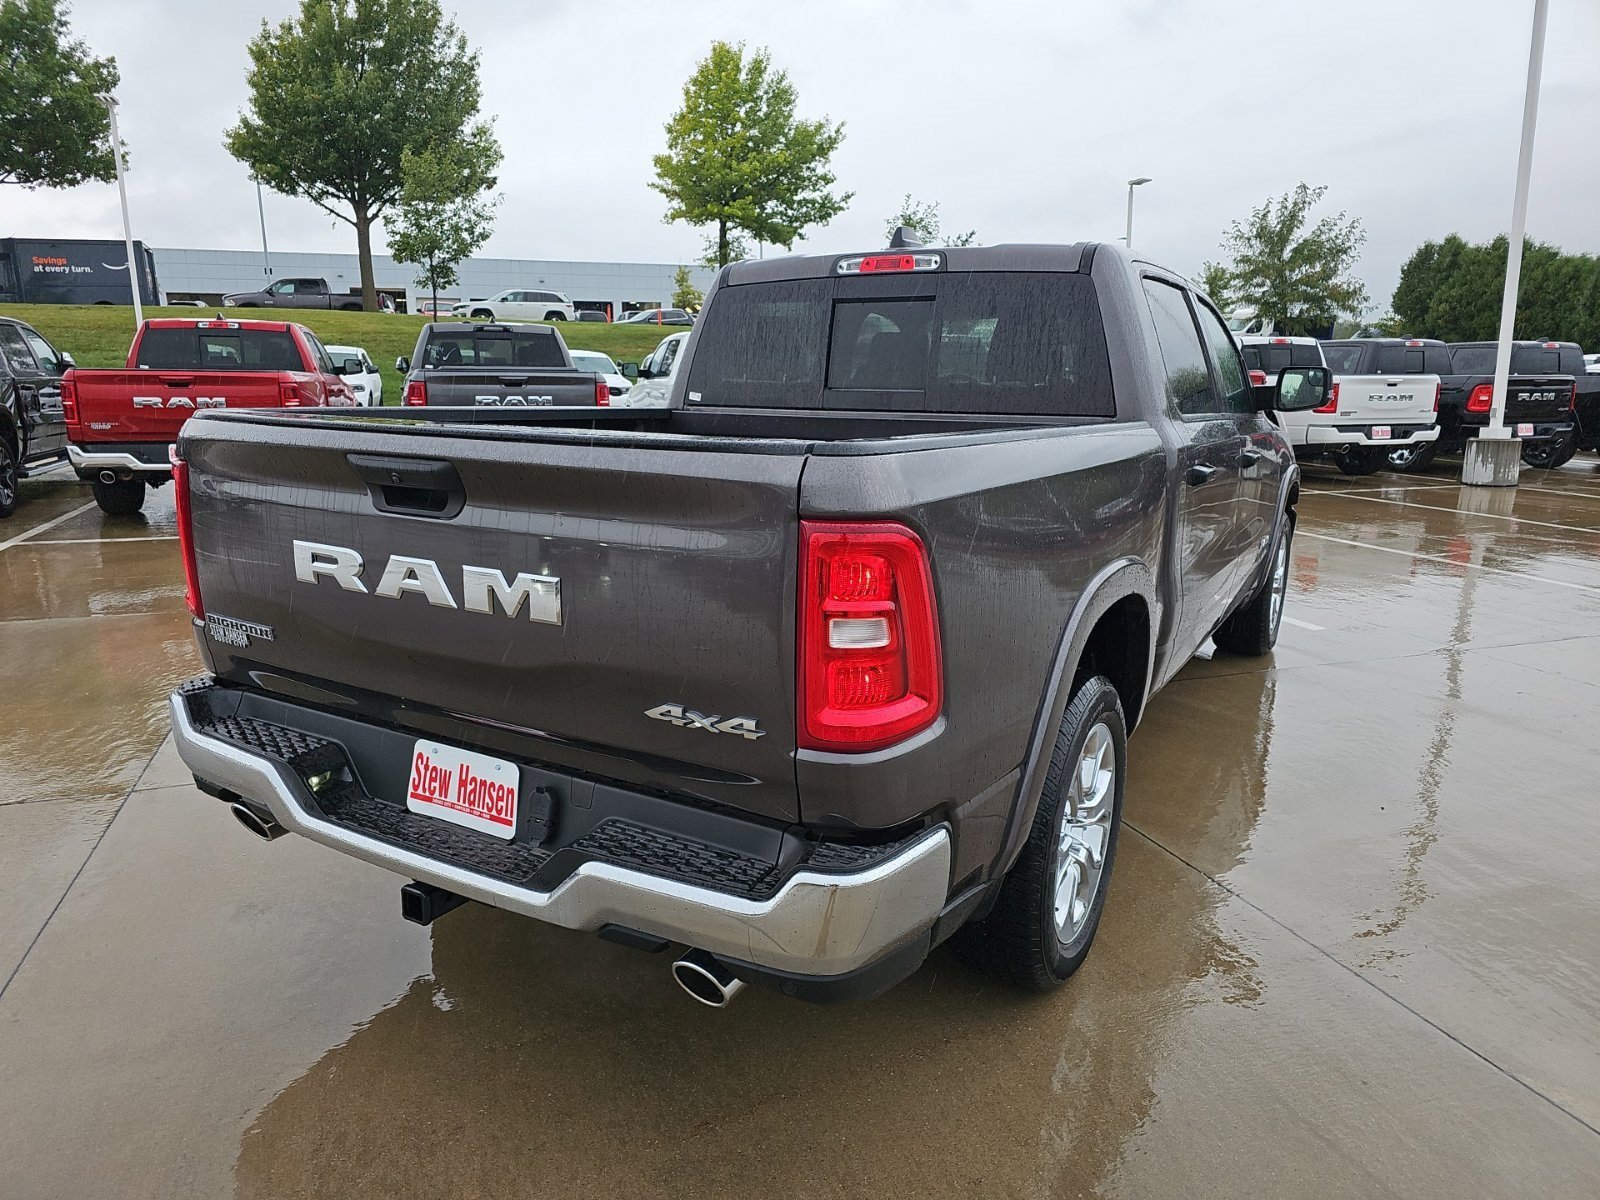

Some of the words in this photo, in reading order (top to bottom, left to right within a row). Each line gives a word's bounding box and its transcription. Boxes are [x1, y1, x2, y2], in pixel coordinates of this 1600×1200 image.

[32, 256, 67, 265] Savings
[34, 264, 44, 273] at
[45, 265, 70, 274] every
[71, 265, 94, 273] turn.
[133, 396, 227, 408] RAM
[475, 395, 553, 406] RAM
[1368, 393, 1414, 402] RAM
[1517, 392, 1556, 401] RAM
[293, 540, 562, 625] RAM
[643, 702, 767, 740] 4x4
[412, 752, 453, 799] Stew
[457, 763, 515, 818] Hansen
